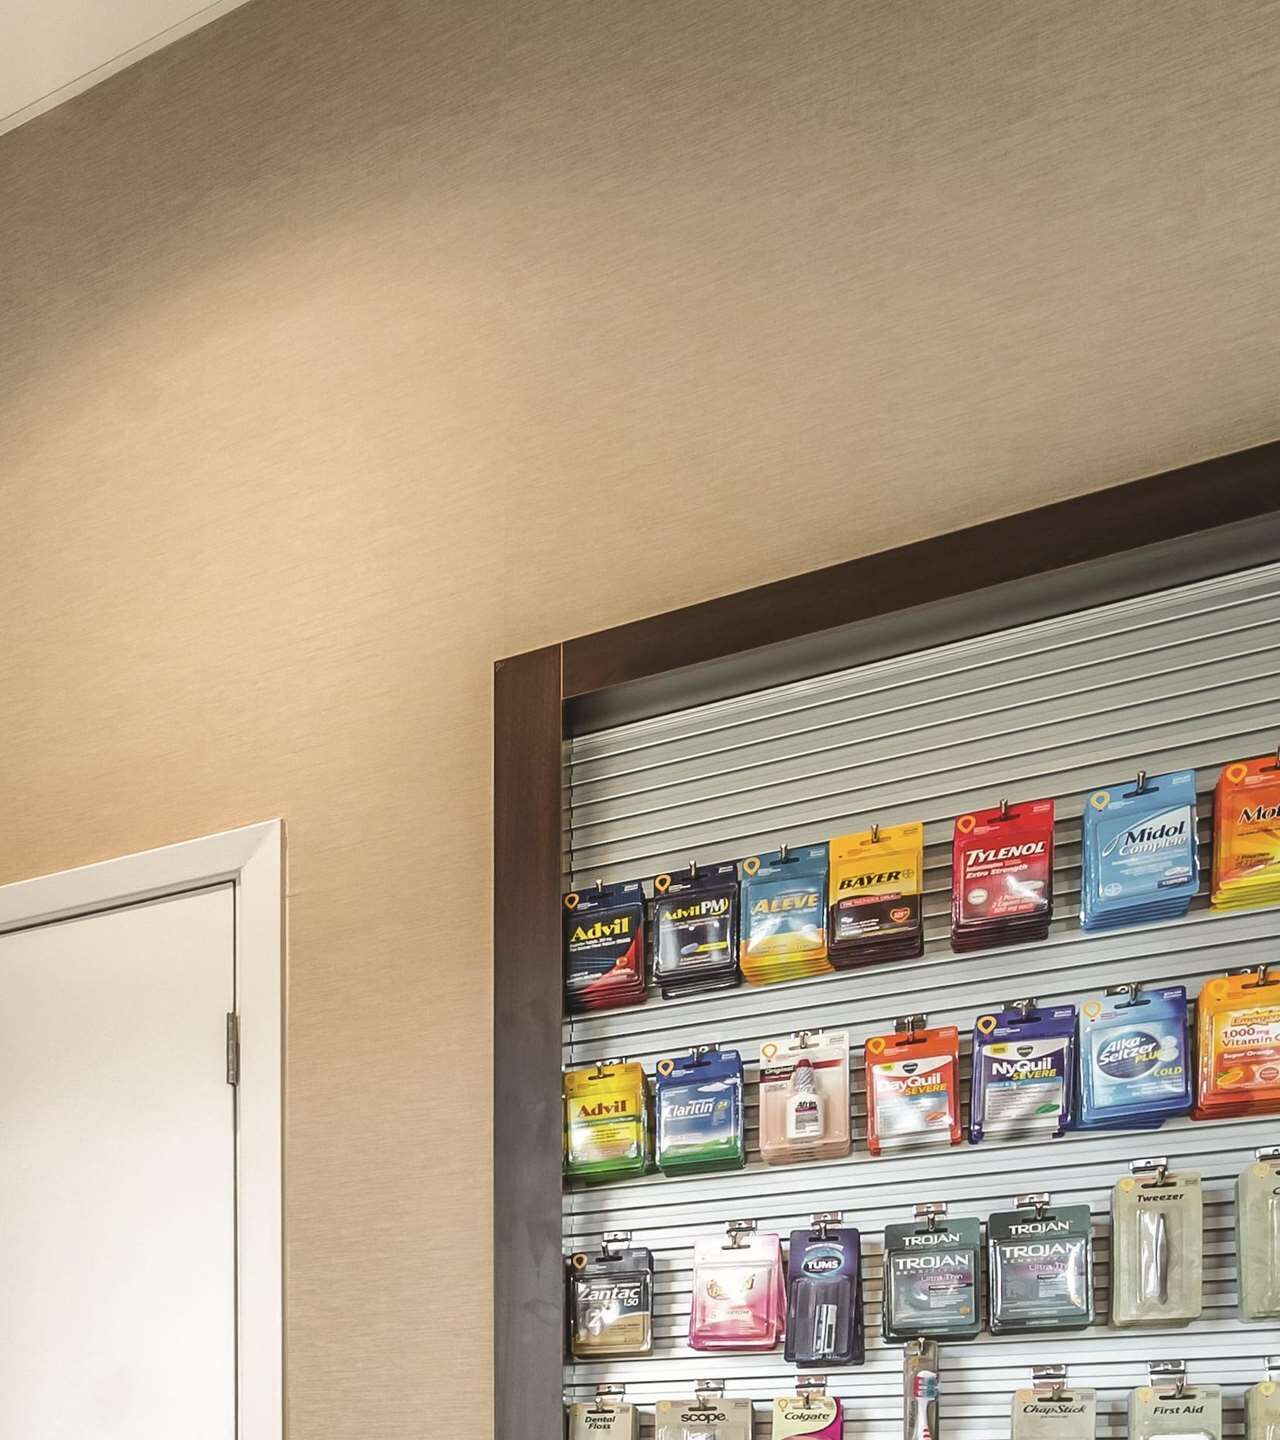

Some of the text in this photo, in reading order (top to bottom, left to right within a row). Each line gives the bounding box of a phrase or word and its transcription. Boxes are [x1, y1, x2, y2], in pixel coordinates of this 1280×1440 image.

[1125, 821, 1186, 846] Midol
[966, 841, 1045, 867] TYLENOL
[1118, 835, 1186, 858] Complete
[966, 863, 1028, 879] Extra Strength
[839, 871, 900, 890] BAYER
[570, 918, 630, 943] Advil
[1222, 1027, 1255, 1038] 1000
[1106, 1036, 1147, 1054] Alka-
[1221, 1035, 1273, 1047] Vitamin
[1099, 1042, 1156, 1066] Seltzer
[992, 1056, 1053, 1080] NyQuil
[1012, 1068, 1057, 1080] SEVERE
[1153, 1066, 1183, 1077] COLD
[904, 1080, 948, 1096] SEVERE
[577, 1100, 627, 1118] Advil
[1136, 1192, 1185, 1202] Tweezer
[1008, 1221, 1070, 1236] TROJAN
[902, 1233, 960, 1247] TROJAN
[807, 1258, 838, 1269] TUMS
[895, 1254, 969, 1270] TROJAN
[680, 1412, 726, 1423] scope
[784, 1411, 830, 1423] Colgate
[1153, 1405, 1204, 1415] First Aid
[584, 1415, 616, 1424] Dental
